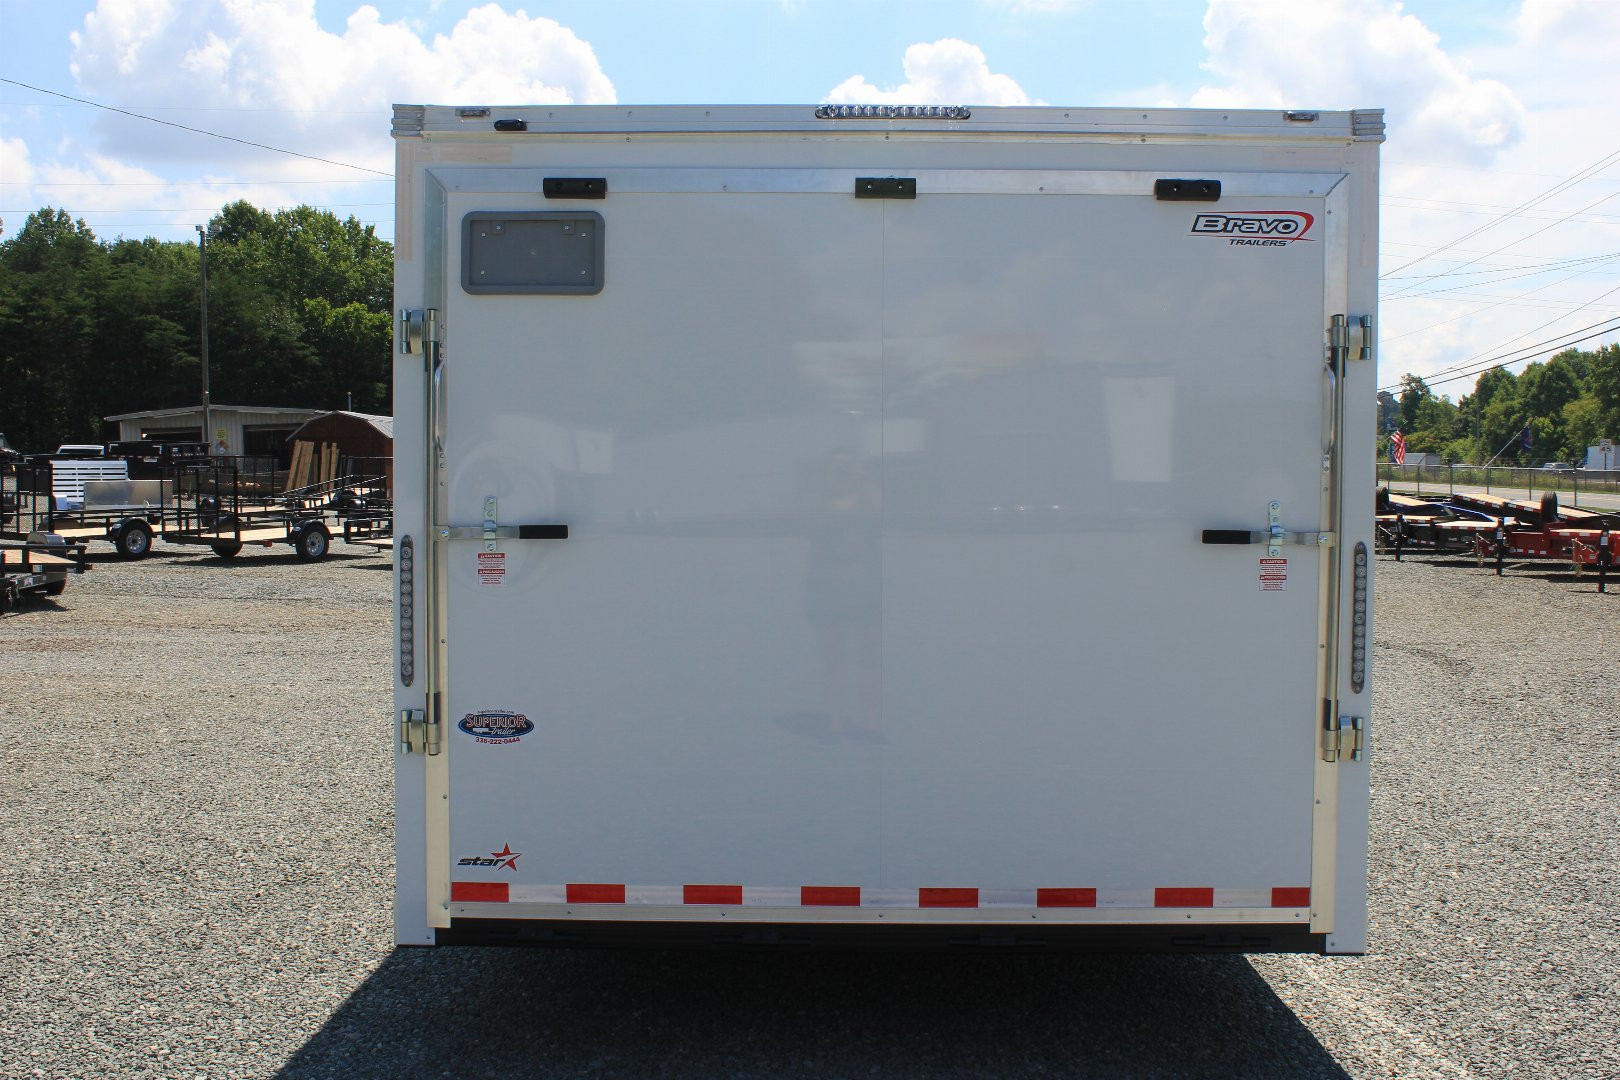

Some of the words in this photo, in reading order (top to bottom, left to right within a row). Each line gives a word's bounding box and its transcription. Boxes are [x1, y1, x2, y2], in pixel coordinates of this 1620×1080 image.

[1191, 214, 1299, 234] Bravo
[1229, 238, 1288, 247] TRAILERS
[465, 713, 527, 728] SUPERIOR
